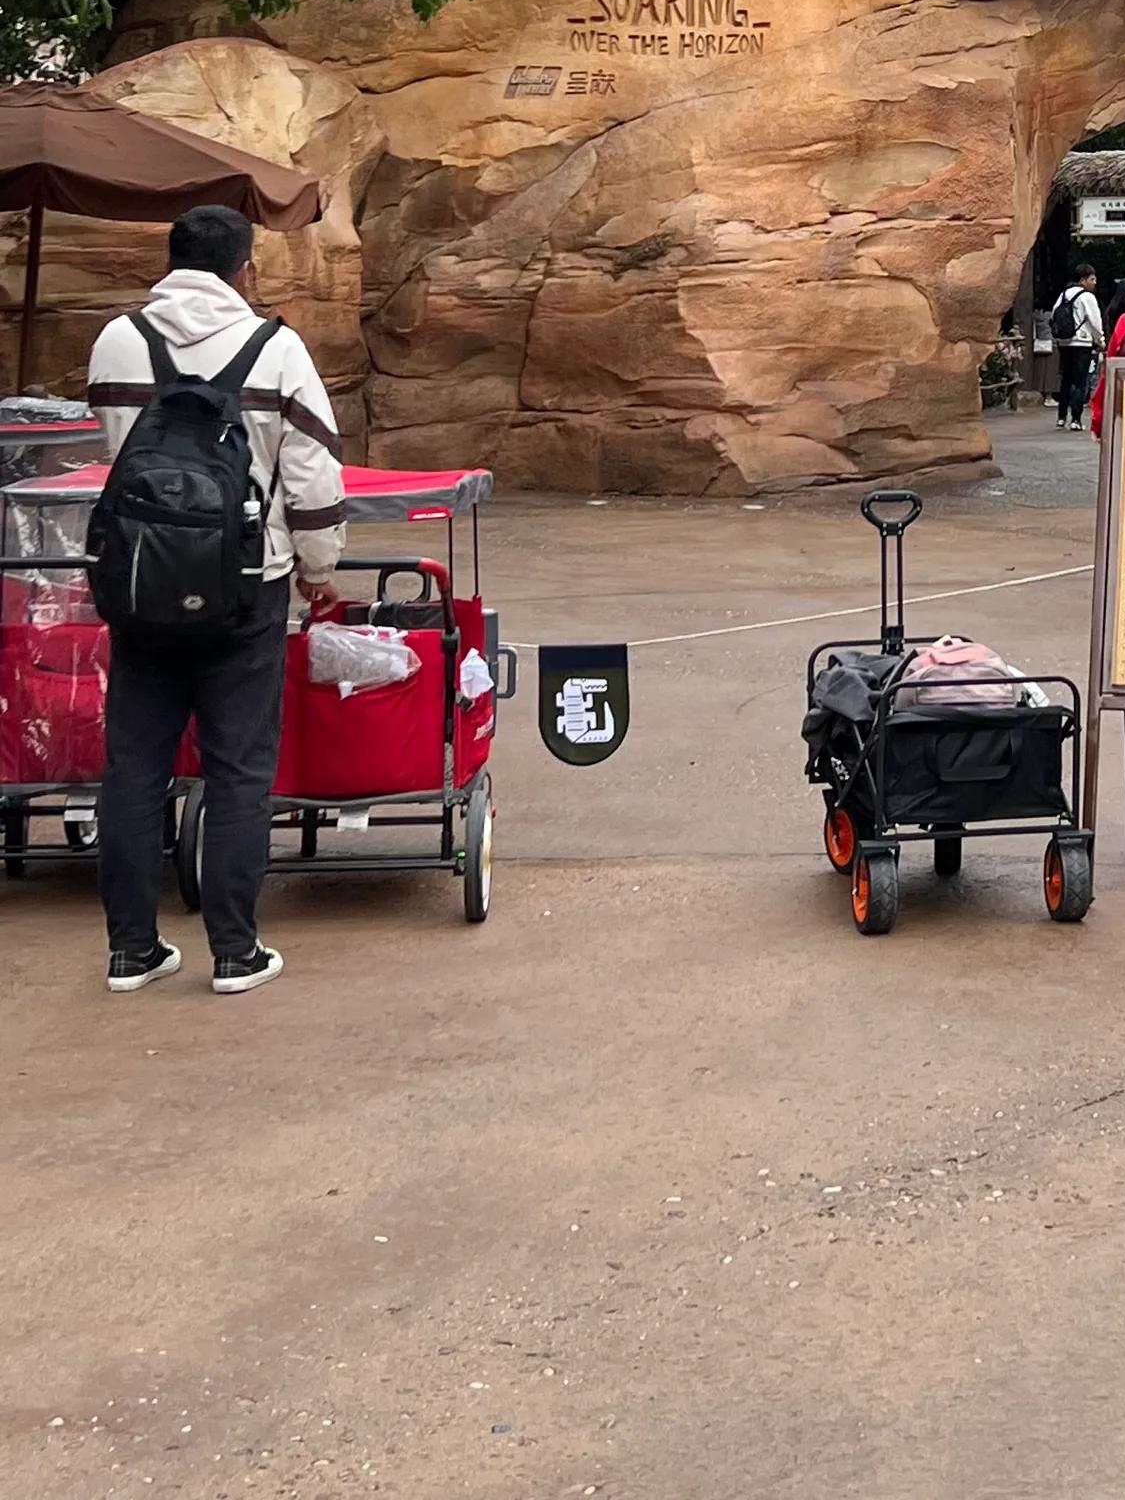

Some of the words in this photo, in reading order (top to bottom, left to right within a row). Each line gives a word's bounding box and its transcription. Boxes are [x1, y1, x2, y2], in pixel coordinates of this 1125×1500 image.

[569, 30, 621, 56] OVER
[628, 33, 670, 57] THE
[678, 31, 766, 59] HORIZON
